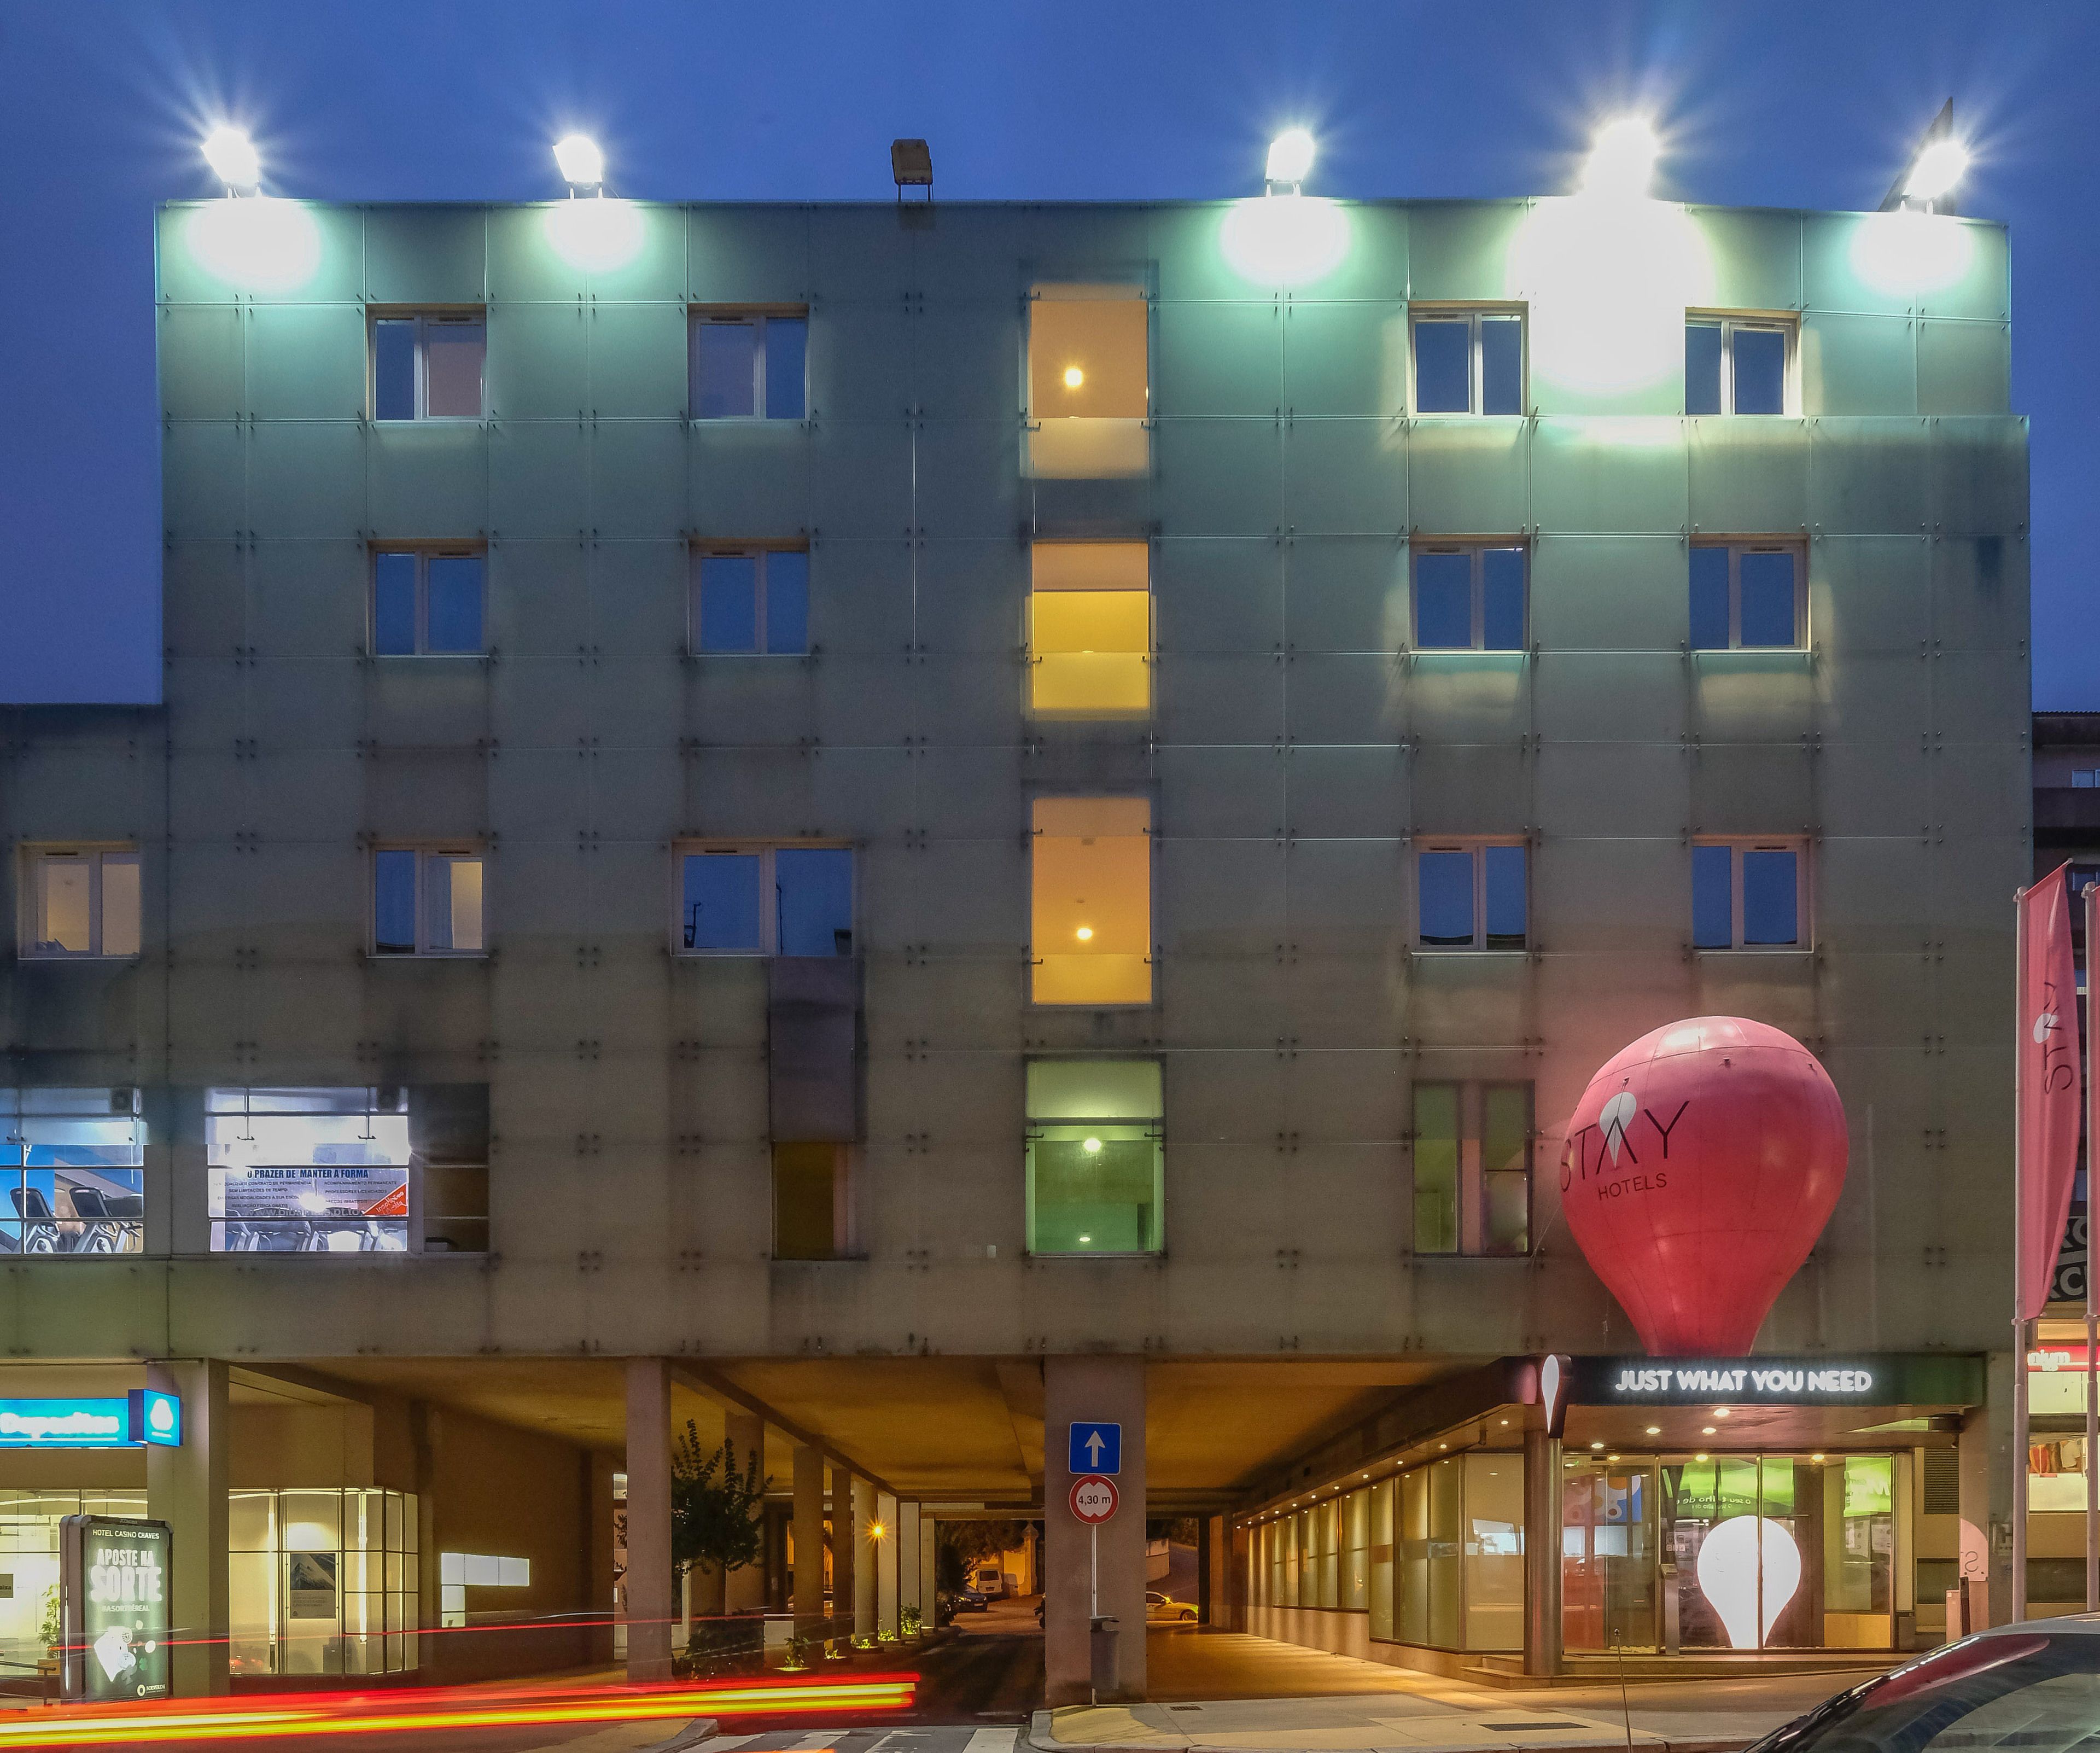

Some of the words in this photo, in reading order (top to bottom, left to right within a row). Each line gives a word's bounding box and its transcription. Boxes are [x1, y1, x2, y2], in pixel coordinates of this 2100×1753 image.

[1561, 1100, 1690, 1192] STAY
[254, 1169, 284, 1178] PRAZER
[286, 1169, 296, 1178] DE
[300, 1169, 332, 1178] MANTER
[334, 1169, 340, 1178] A
[341, 1169, 369, 1178] FORMA
[1597, 1173, 1667, 1201] HOTELS
[1615, 1370, 1673, 1391] JUST
[1676, 1370, 1747, 1391] WHAT
[1752, 1370, 1804, 1391] YOU
[1809, 1371, 1872, 1391] NEED
[1078, 1495, 1098, 1506] 4,30
[97, 1548, 138, 1566] APOSTE
[141, 1551, 155, 1567] NA
[90, 1565, 162, 1602] SORTE
